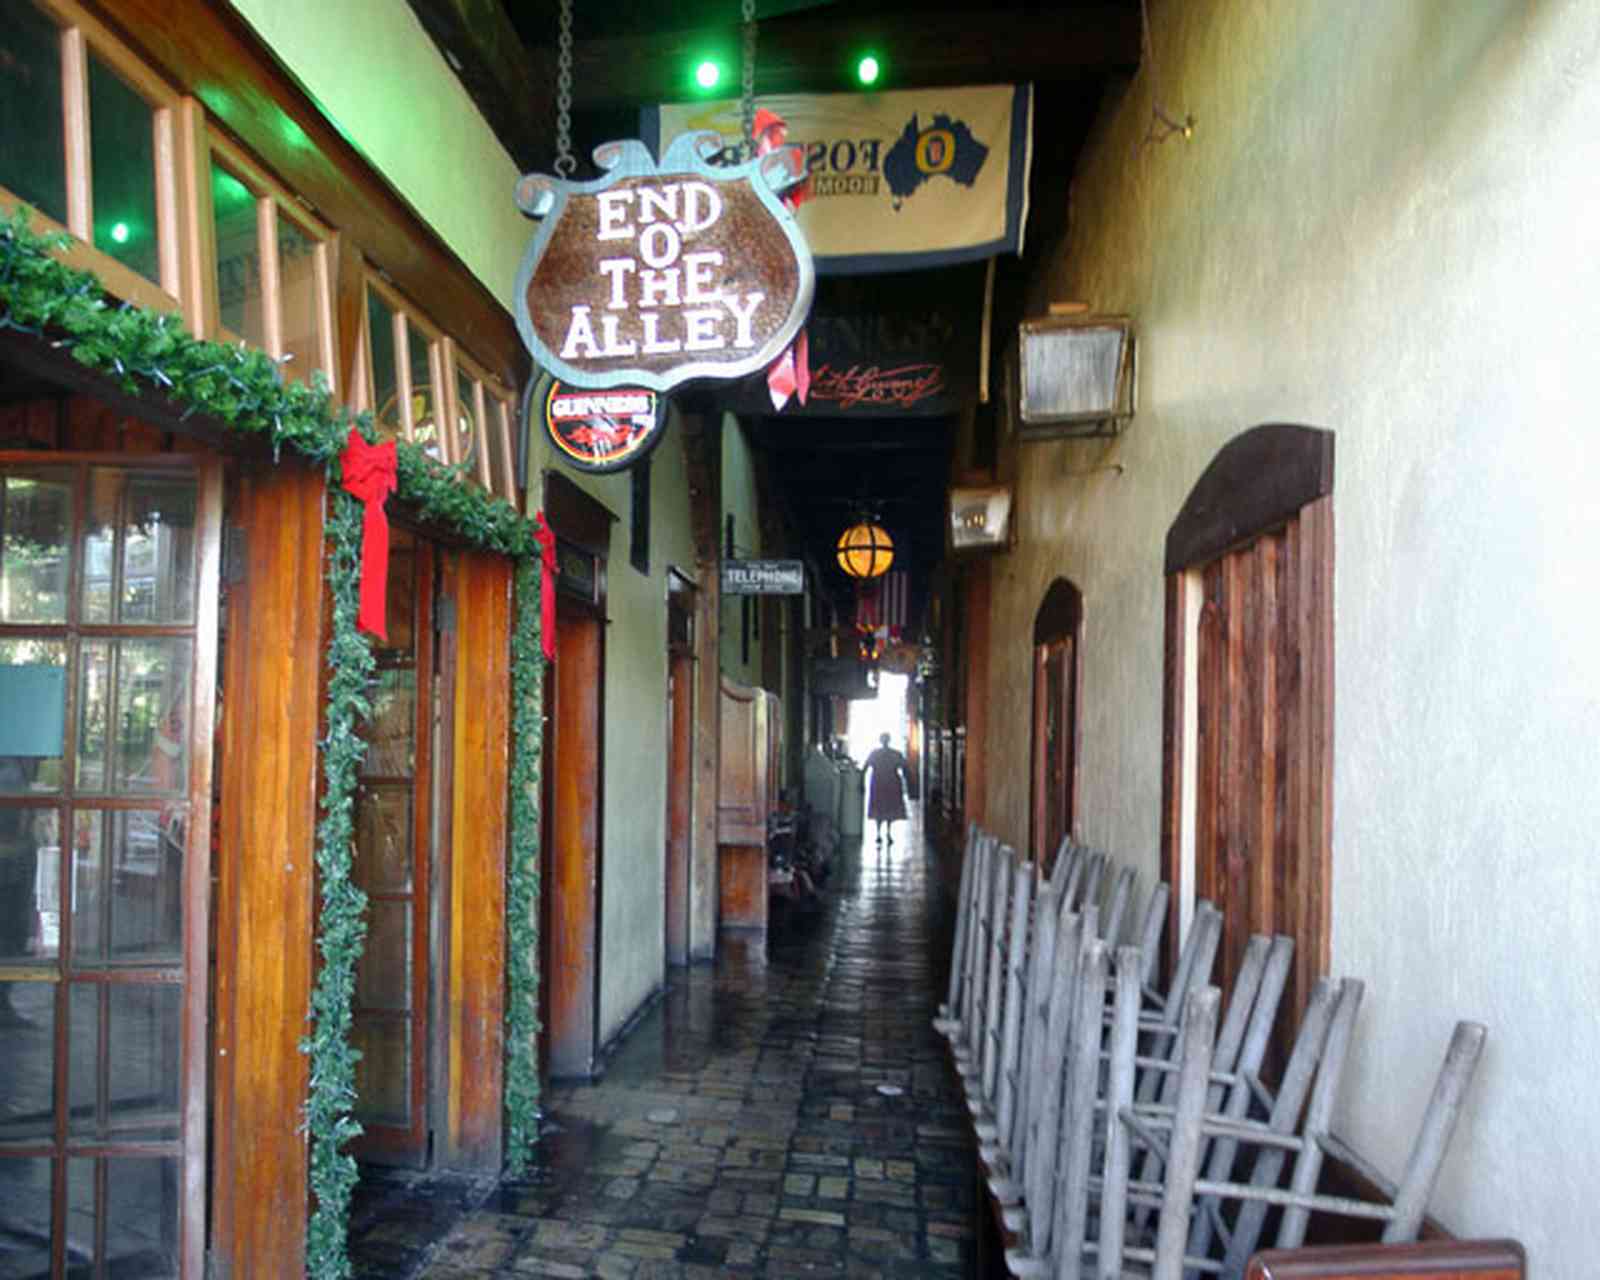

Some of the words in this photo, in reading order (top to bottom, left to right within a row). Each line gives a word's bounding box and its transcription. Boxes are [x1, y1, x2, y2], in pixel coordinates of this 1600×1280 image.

[596, 181, 722, 240] END
[639, 221, 681, 269] O
[600, 251, 723, 309] THE
[560, 292, 765, 358] ALLEY
